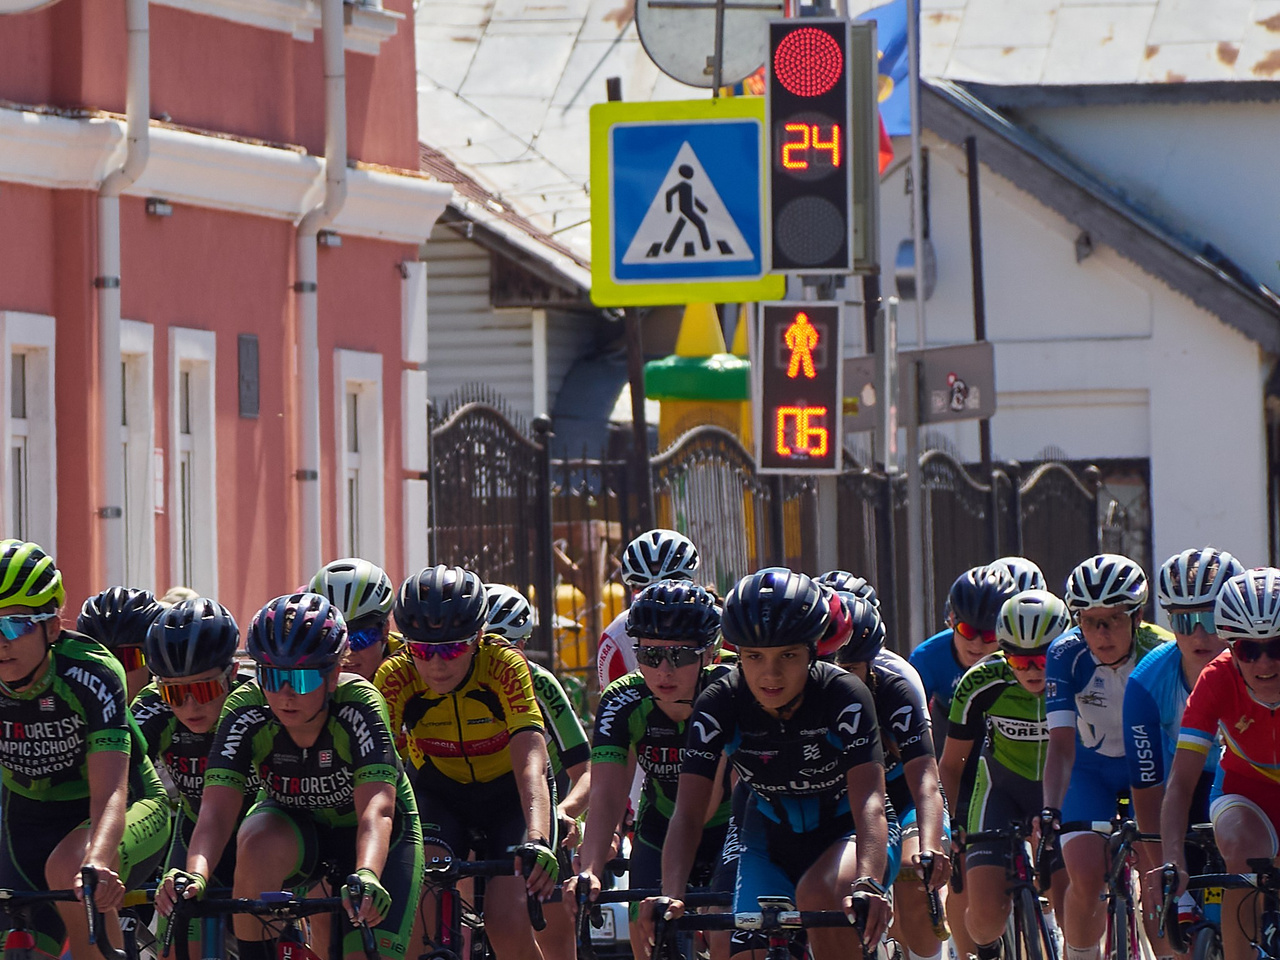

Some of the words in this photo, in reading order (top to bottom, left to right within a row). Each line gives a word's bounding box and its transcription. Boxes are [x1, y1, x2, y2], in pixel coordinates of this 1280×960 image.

[782, 123, 841, 170] 24
[776, 405, 828, 457] 06
[64, 665, 118, 723] MICHE
[532, 671, 569, 720] SSIA
[954, 663, 1016, 704] RUSSIA
[220, 709, 266, 760] MICHE
[338, 705, 375, 758] MICHE
[598, 687, 642, 737] MICHE
[33, 732, 85, 757] SCHOOL
[1131, 724, 1157, 783] RUSSIA
[260, 764, 354, 796] SESTRORETSK
[308, 783, 355, 806] SCHOOL
[789, 773, 845, 791] Union
